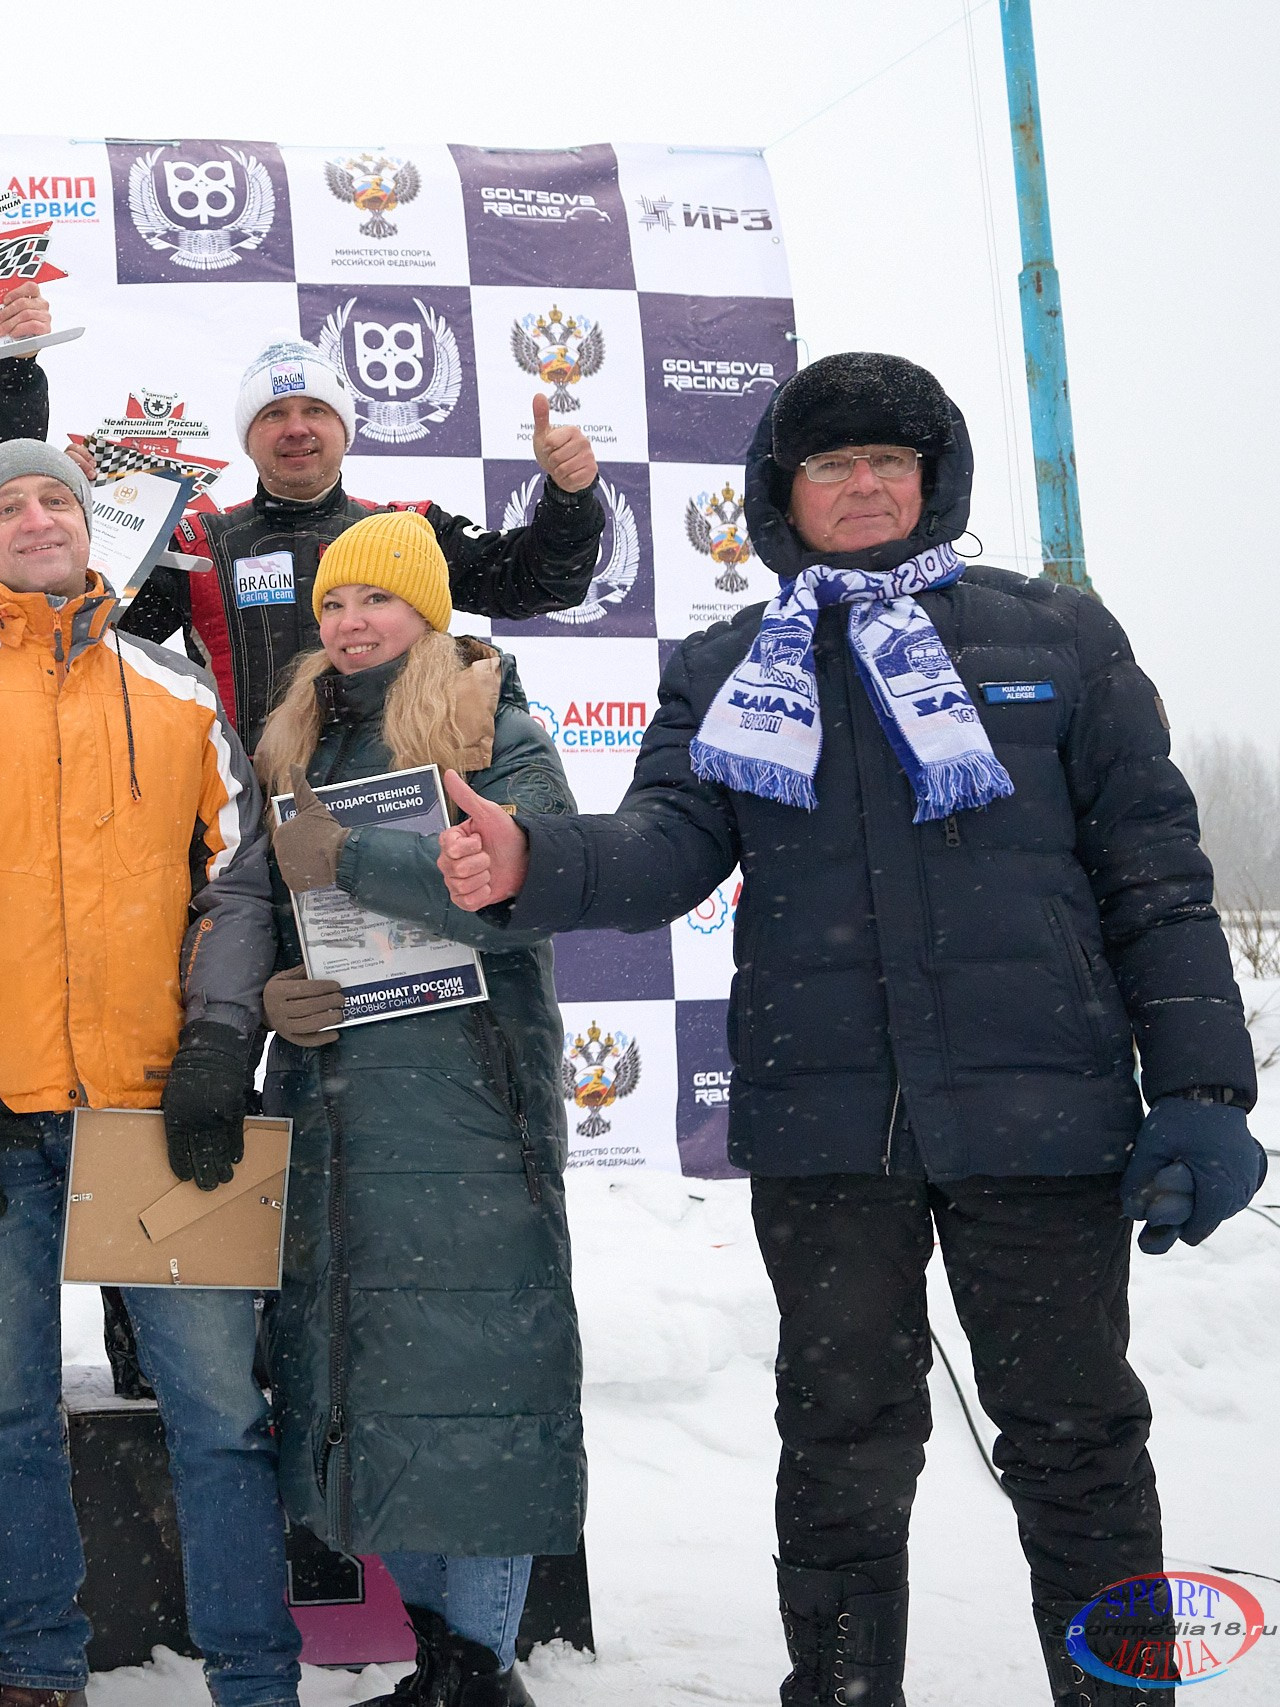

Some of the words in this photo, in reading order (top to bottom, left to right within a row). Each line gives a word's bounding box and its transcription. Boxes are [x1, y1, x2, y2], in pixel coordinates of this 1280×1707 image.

[8, 176, 96, 200] АКПП
[481, 187, 595, 207] GOLTSOVA
[483, 201, 562, 219] RACING
[682, 203, 773, 231] ИРЗ
[335, 248, 400, 257] МИНИСТЕРСТВО
[401, 249, 432, 258] СПОРТА
[331, 258, 386, 267] РОССИЙСКОЙ
[387, 259, 437, 268] ФЕДЕРАЦИИ
[663, 359, 774, 376] GOLTSOVA
[273, 373, 303, 386] BRAGIN
[663, 375, 741, 393] RACING
[583, 424, 613, 433] СПОРТА
[239, 573, 293, 593] BRAGIN
[240, 590, 269, 603] Racing
[270, 589, 294, 600] Team
[692, 603, 747, 612] МИНИСТЕРСТВ
[689, 613, 732, 622] РОССИЙСКО
[1002, 685, 1036, 694] KULAKOV
[1006, 691, 1036, 700] ALEKSEI
[562, 701, 646, 727] АКПП
[563, 730, 643, 746] СЕРВИС
[324, 784, 421, 812] АГОДАРСТВЕННОЕ
[377, 797, 423, 815] ПИСЬМО
[342, 986, 409, 1008] ЕМПИОНАТ
[413, 976, 463, 993] РОССИИ
[438, 987, 465, 999] 2025
[566, 1148, 608, 1158] ИСТЕРСТВО
[610, 1146, 640, 1155] СПОРТА
[597, 1157, 646, 1167] ФЕДЕРАЦИИ
